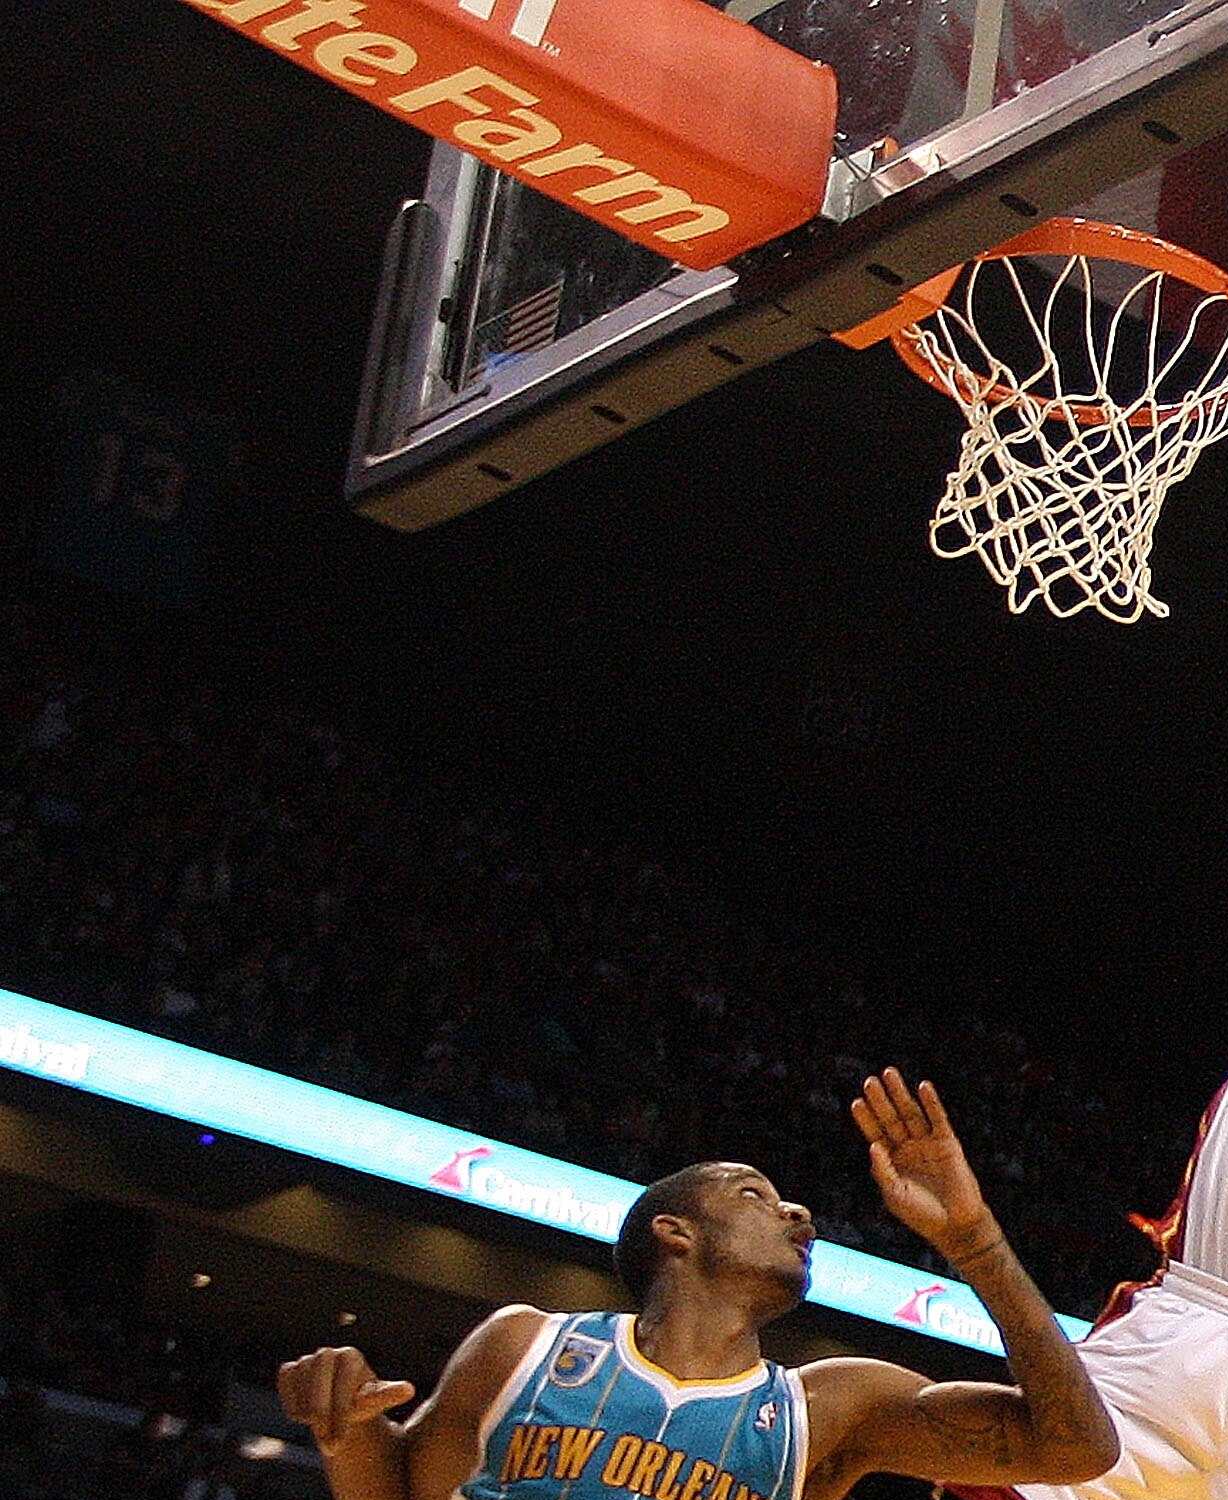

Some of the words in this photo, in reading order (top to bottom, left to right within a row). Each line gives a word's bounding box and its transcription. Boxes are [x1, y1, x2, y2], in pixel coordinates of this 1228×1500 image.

[388, 65, 731, 244] Farm
[471, 1167, 622, 1238] Carnival
[500, 1424, 605, 1484] NEW
